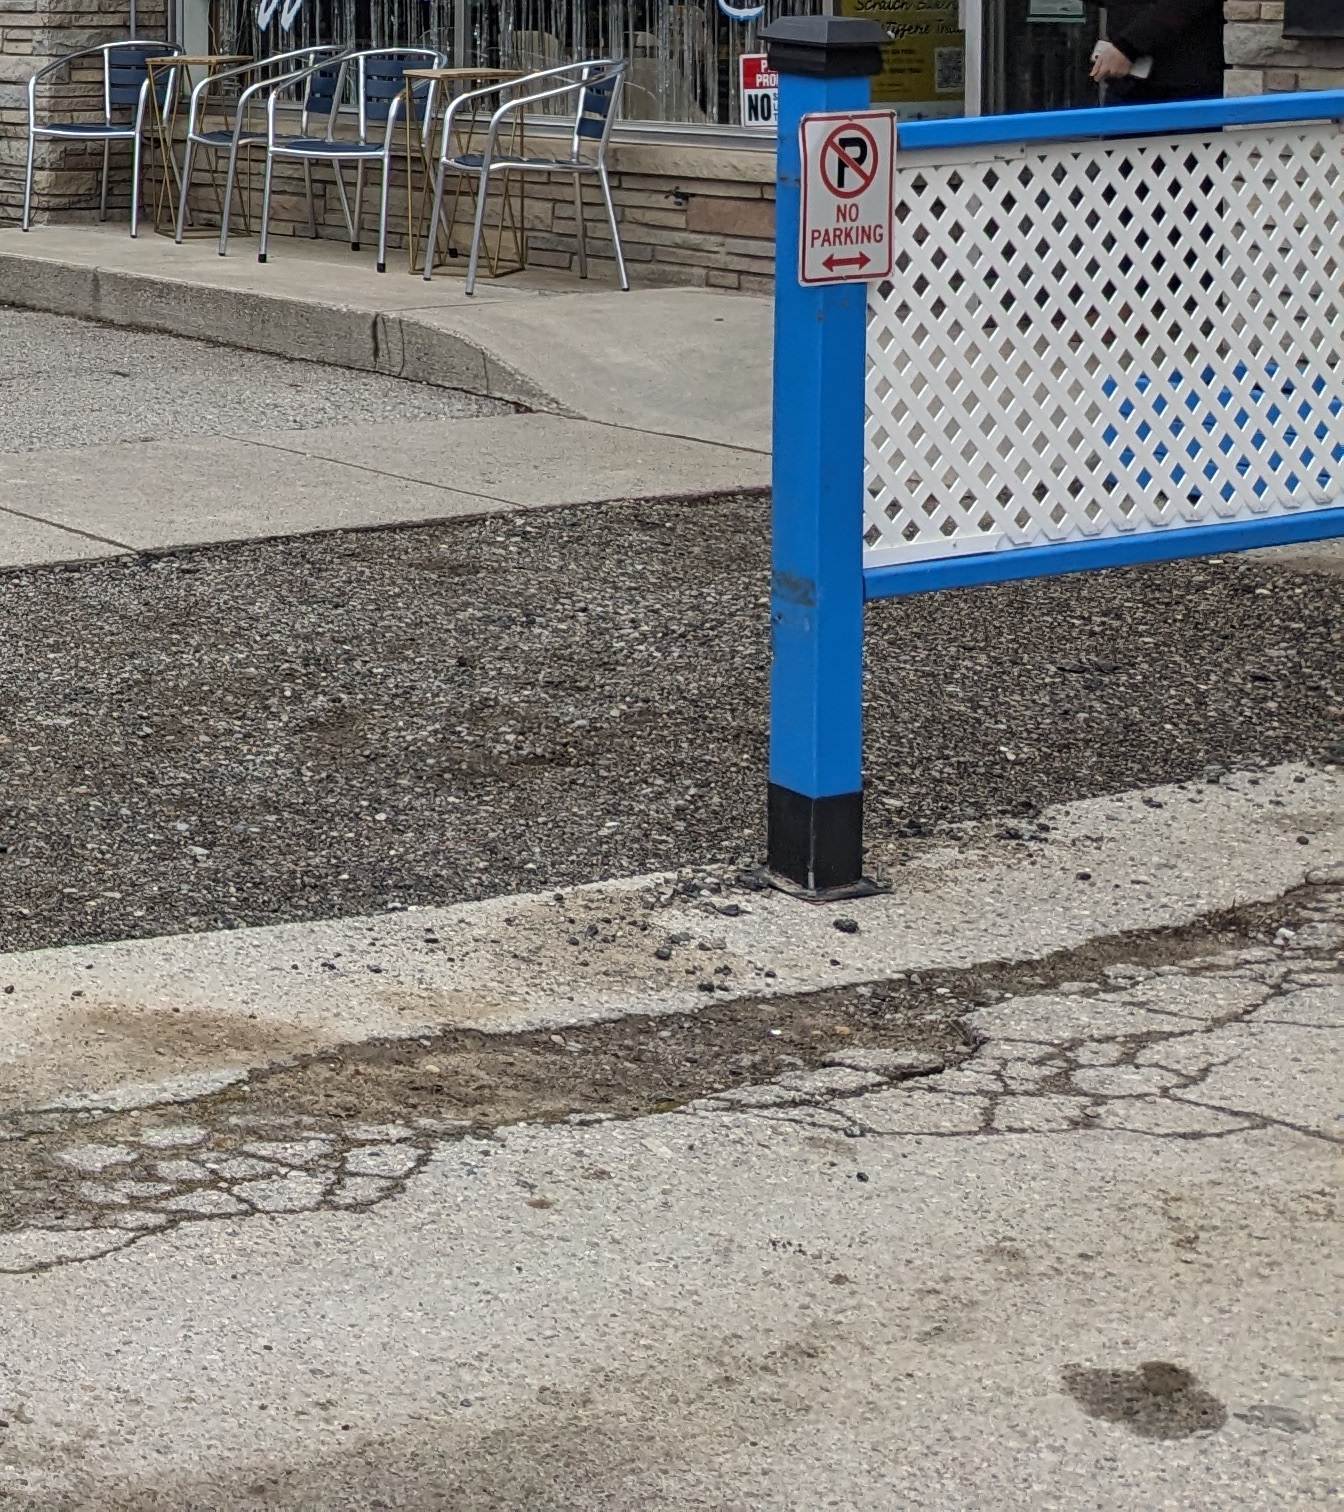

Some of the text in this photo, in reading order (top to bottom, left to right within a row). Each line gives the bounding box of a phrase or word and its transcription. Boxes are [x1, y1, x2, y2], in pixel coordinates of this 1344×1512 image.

[755, 73, 779, 88] PRO
[747, 93, 772, 122] NO
[836, 203, 860, 223] NO
[811, 224, 884, 249] PARKING
